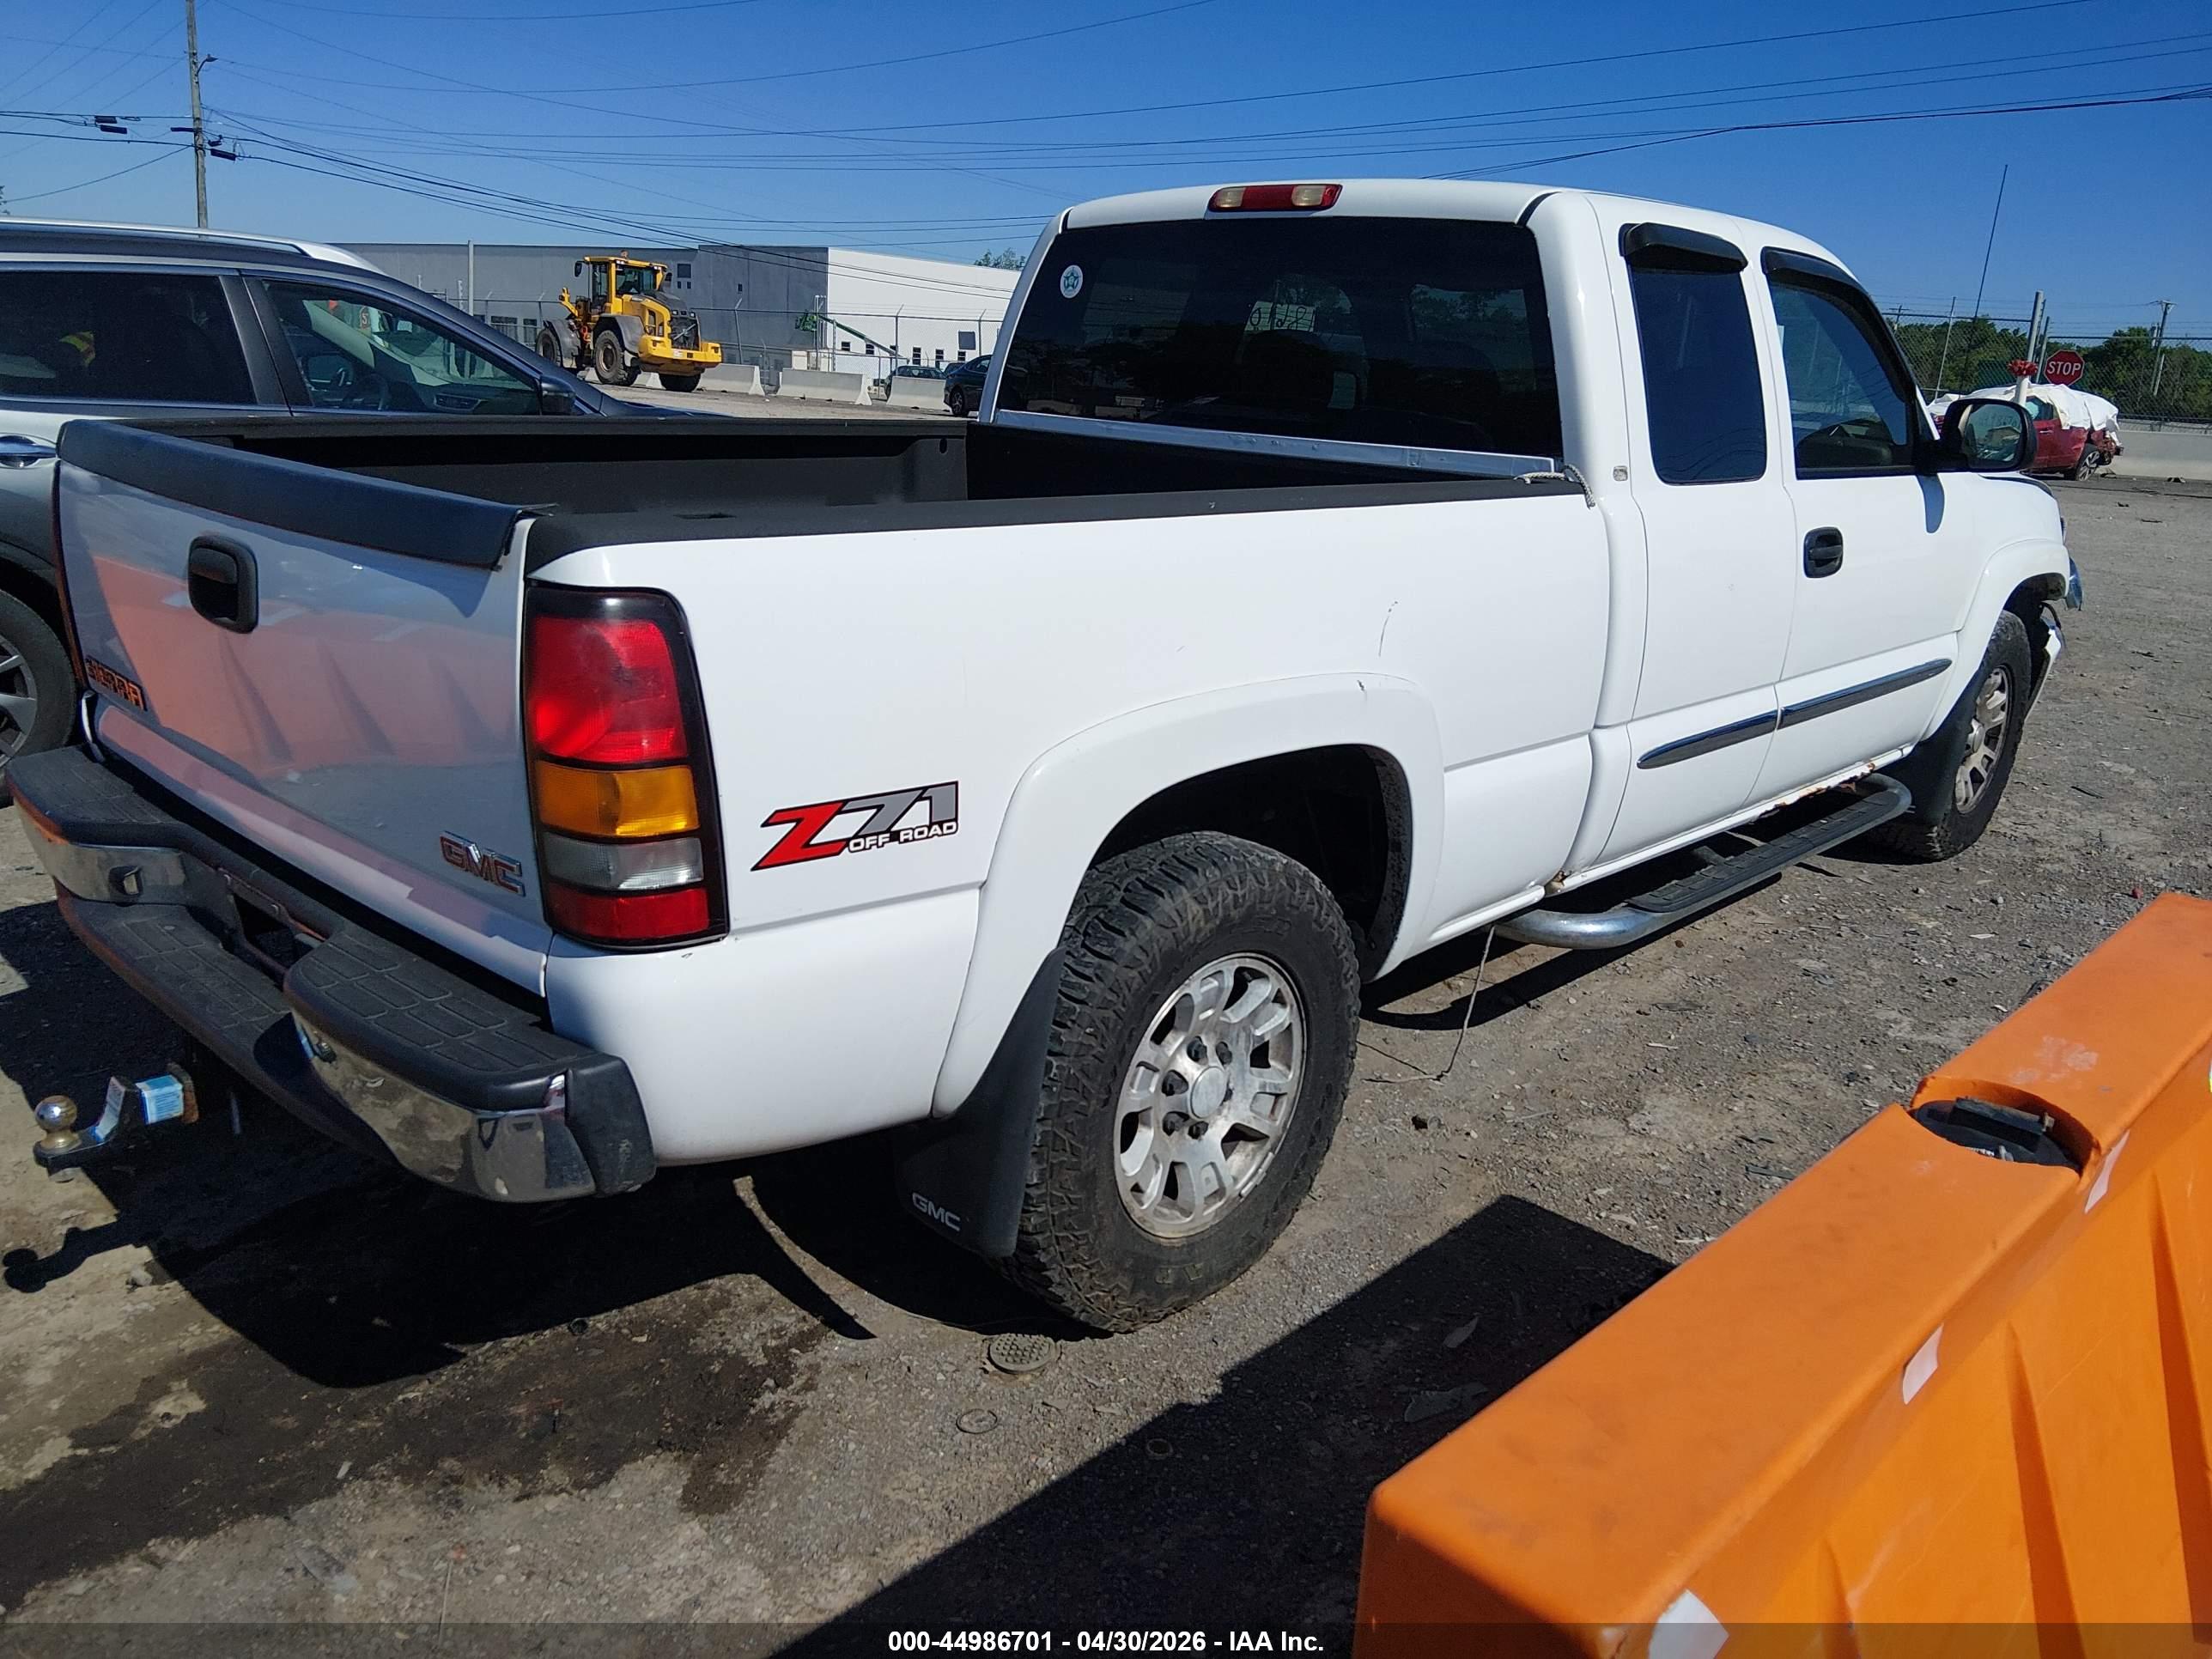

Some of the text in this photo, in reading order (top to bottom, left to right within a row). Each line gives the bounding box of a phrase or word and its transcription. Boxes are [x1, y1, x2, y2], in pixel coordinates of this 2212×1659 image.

[2046, 361, 2081, 376] STOP
[750, 781, 958, 872] Z71
[848, 821, 957, 853] OFF ROAD
[440, 830, 526, 897] GMC
[912, 1192, 961, 1231] GMC
